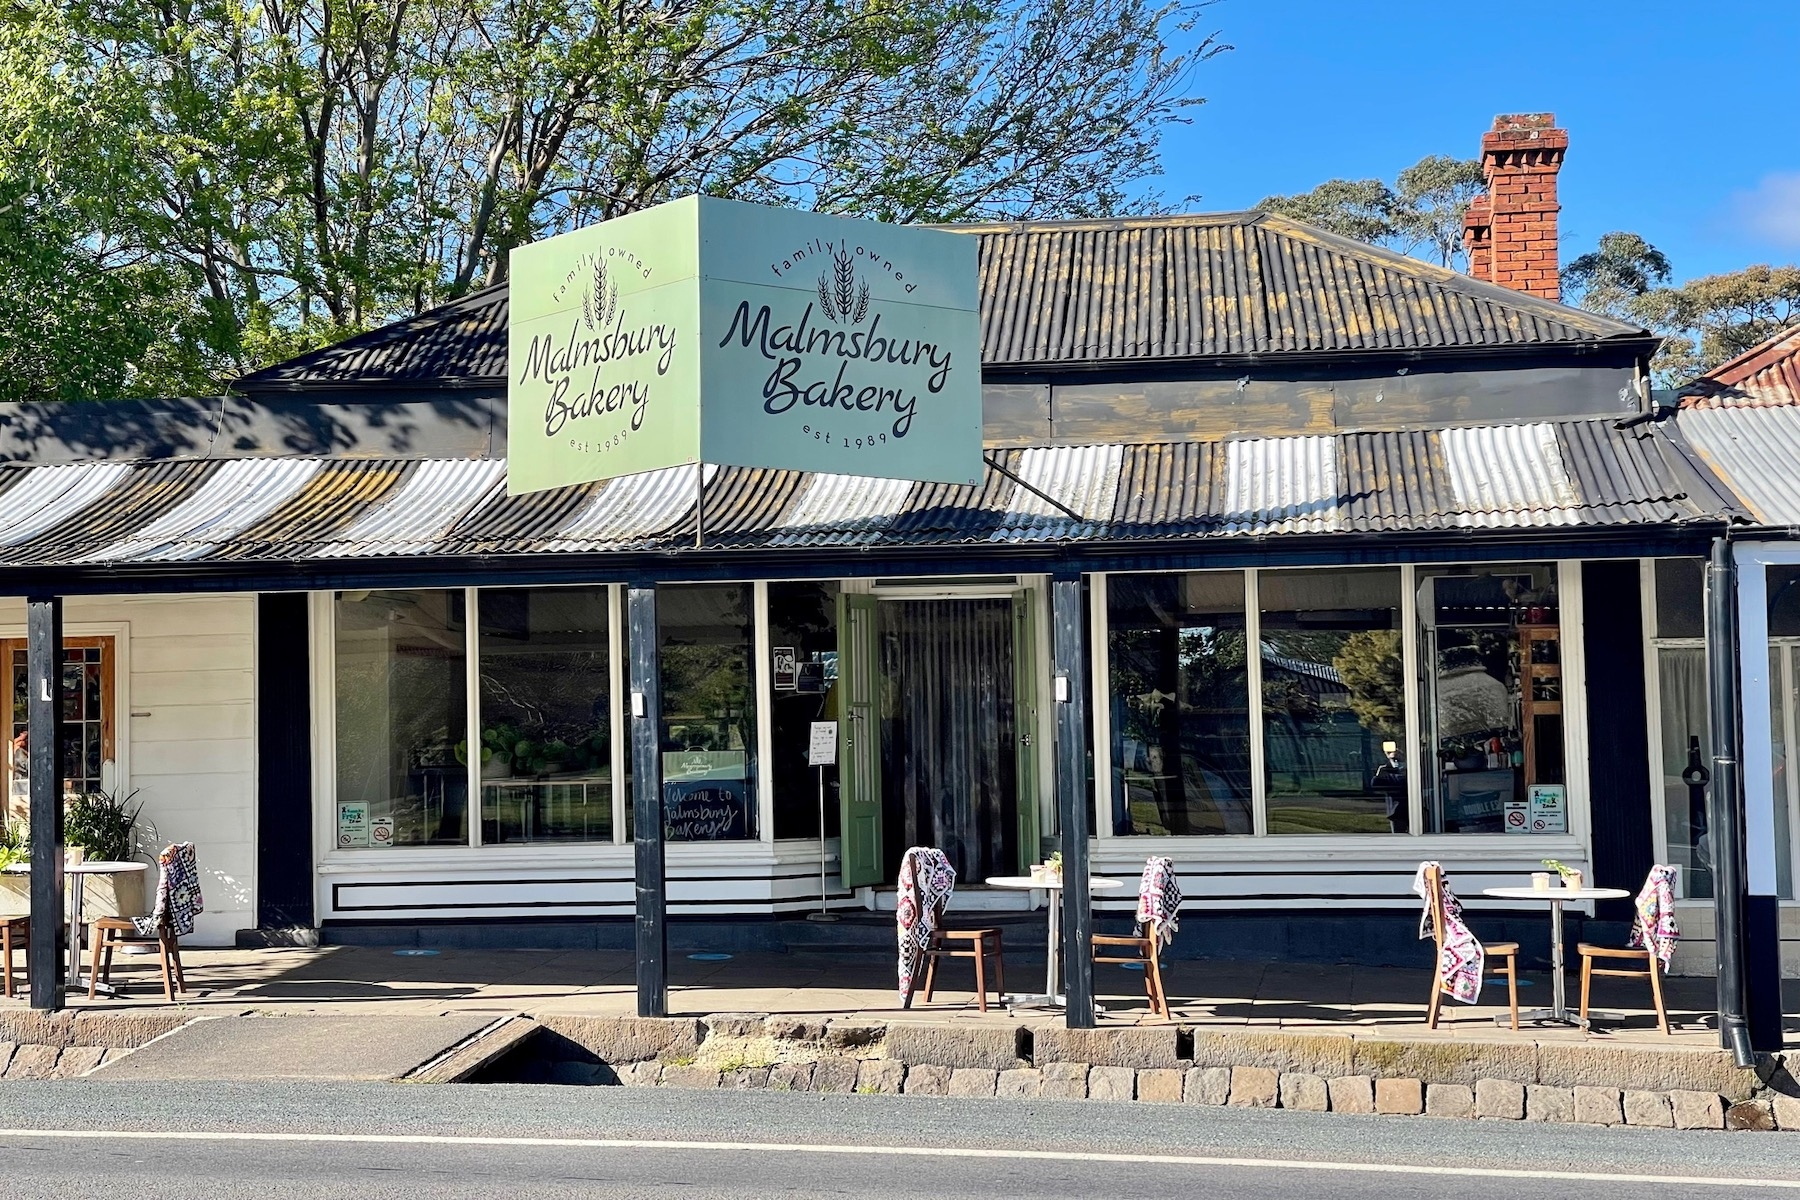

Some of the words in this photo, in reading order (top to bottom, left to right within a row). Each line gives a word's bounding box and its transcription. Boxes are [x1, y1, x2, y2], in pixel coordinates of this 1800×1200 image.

[552, 252, 594, 303] family
[608, 247, 653, 280] owned
[771, 238, 834, 277] family
[856, 245, 918, 293] owned
[519, 309, 677, 386] Malmsbury
[719, 300, 953, 393] Malmsbury
[545, 366, 649, 437] Bakery
[763, 357, 918, 438] Bakery
[569, 438, 590, 453] est
[596, 429, 628, 453] 1989
[802, 424, 831, 444] est
[843, 432, 887, 450] 1989
[719, 787, 732, 801] to
